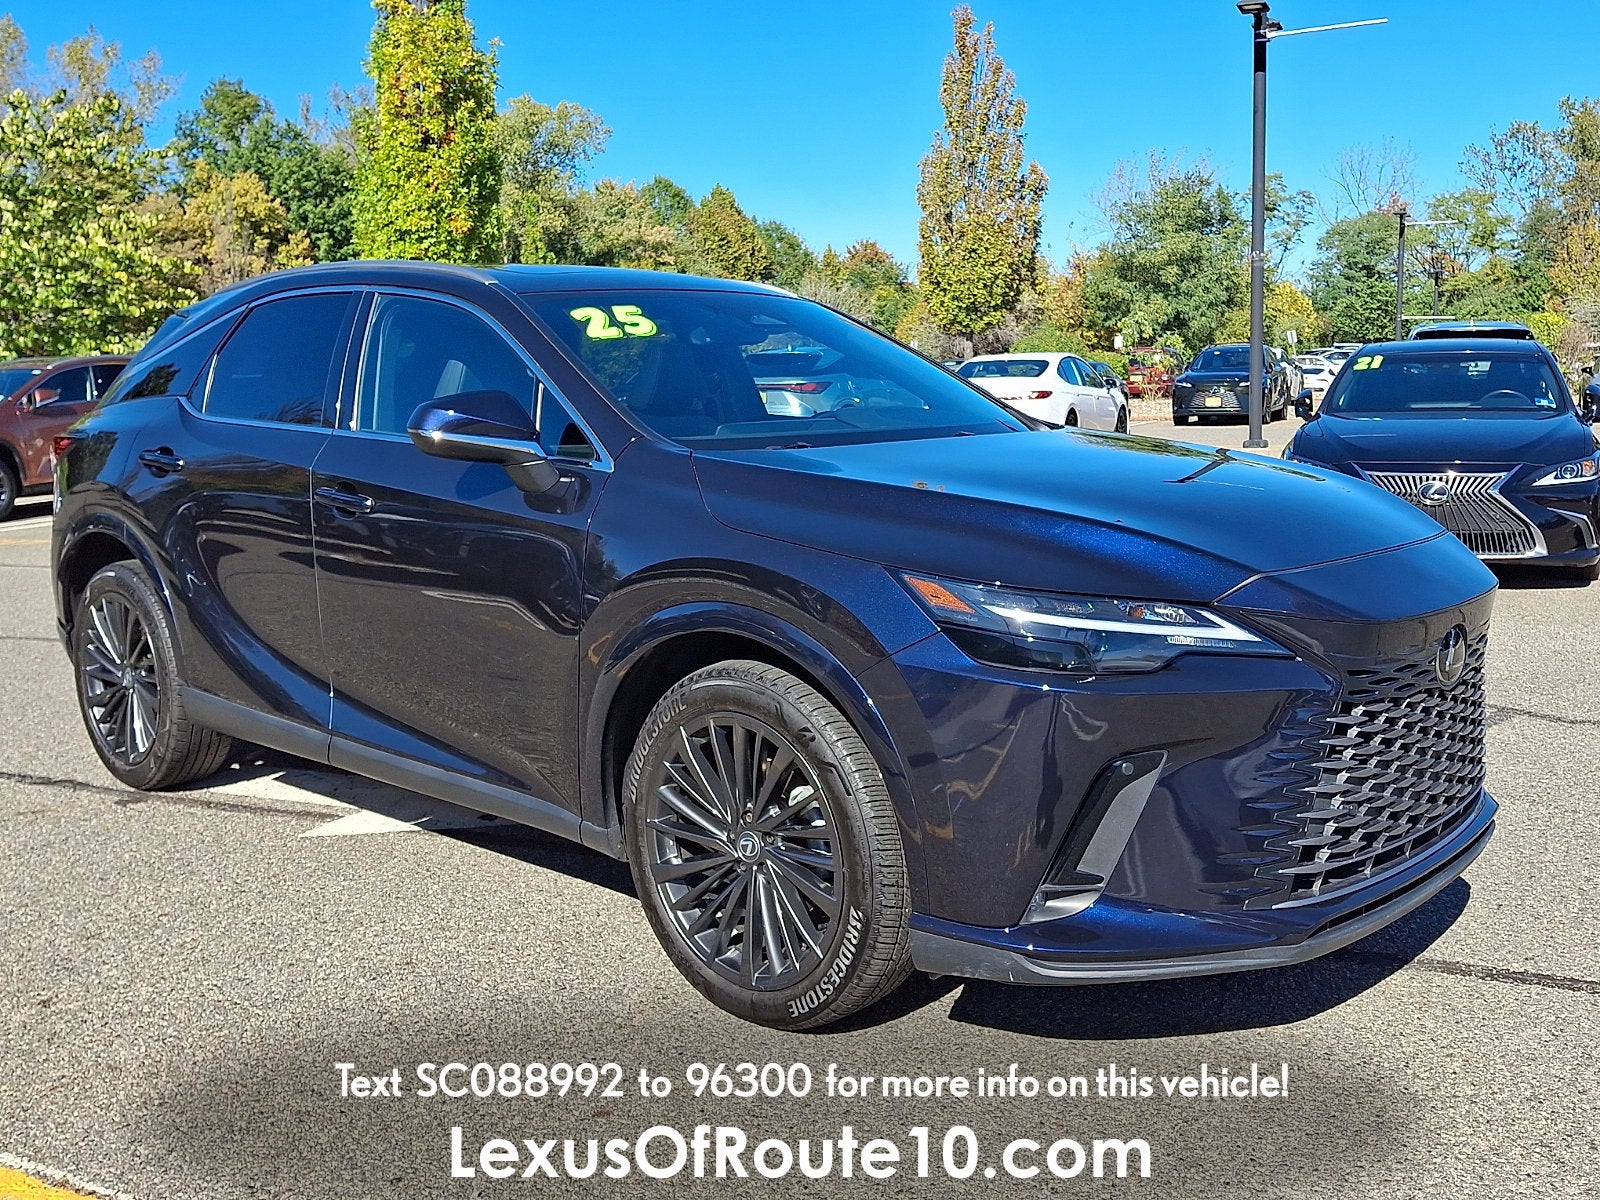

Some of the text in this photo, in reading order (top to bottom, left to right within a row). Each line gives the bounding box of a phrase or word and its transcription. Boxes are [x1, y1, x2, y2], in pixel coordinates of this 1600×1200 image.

[569, 304, 658, 340] 25
[1353, 355, 1384, 371] 21
[787, 904, 867, 1018] BRIDGESTONE
